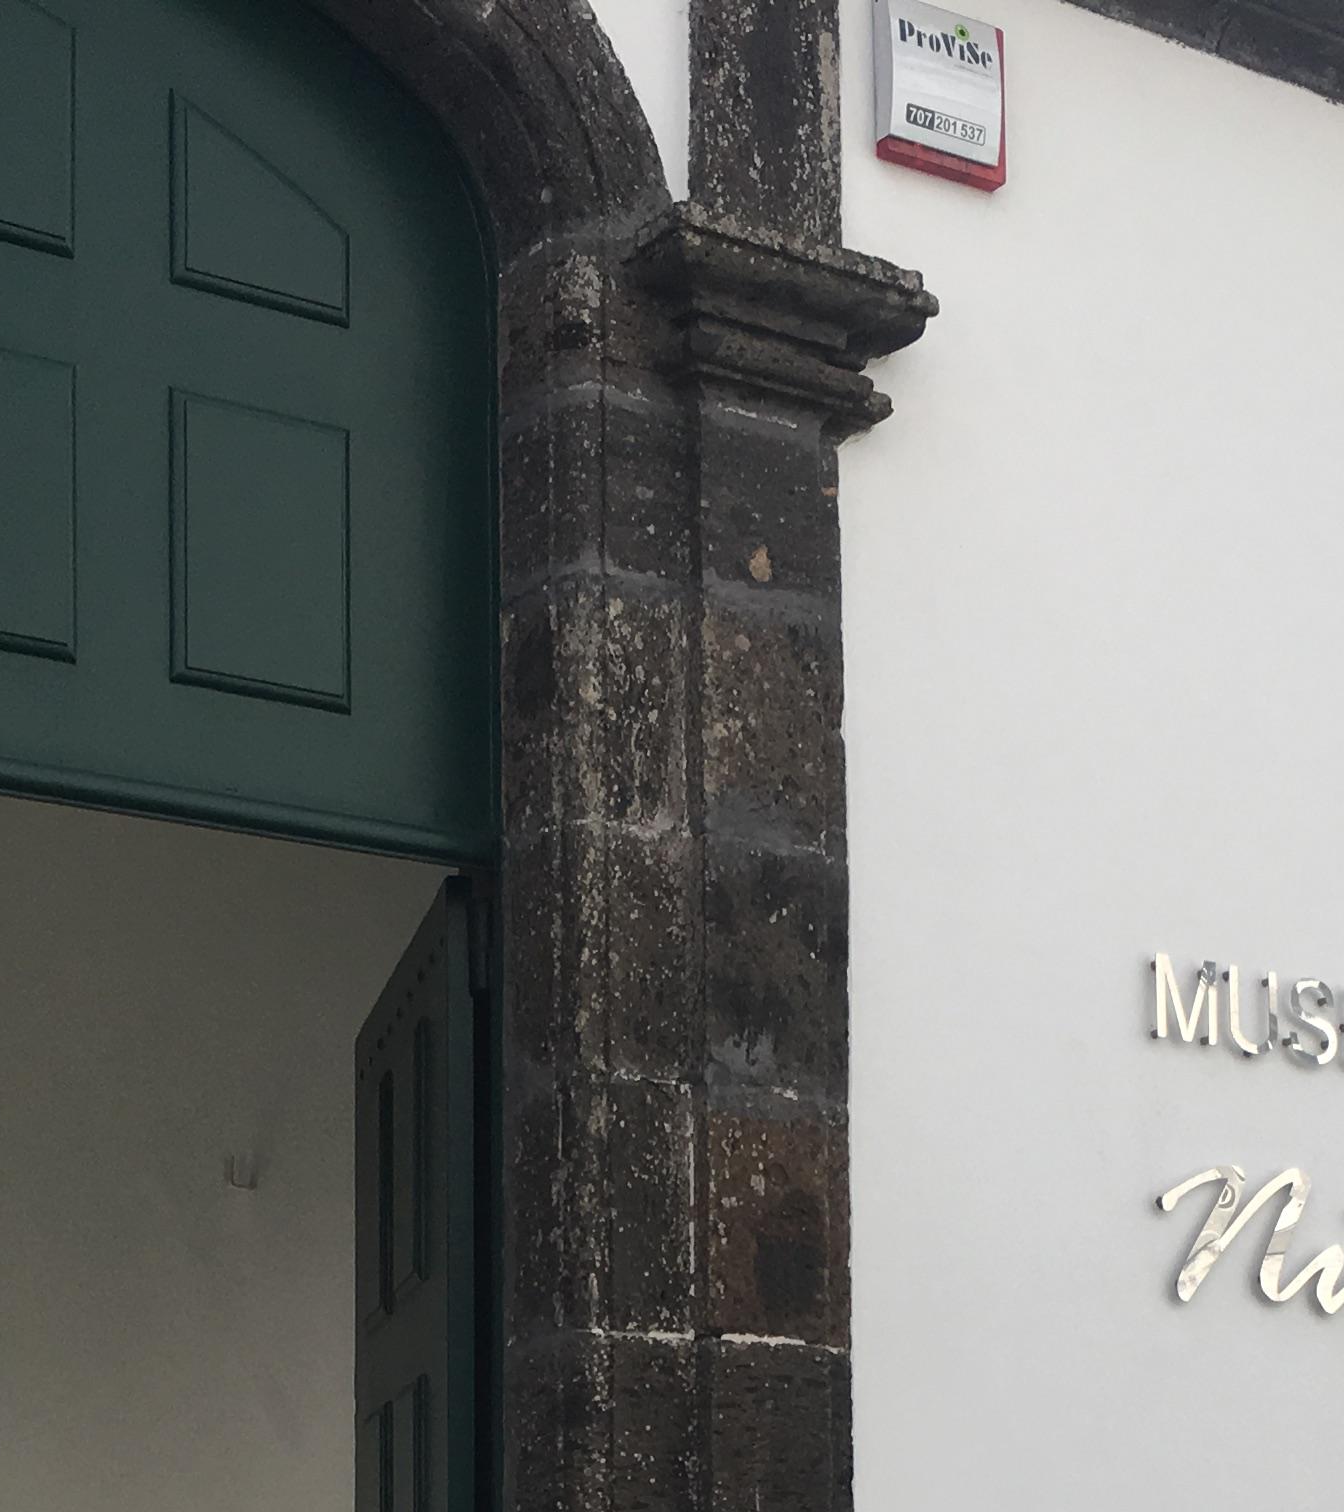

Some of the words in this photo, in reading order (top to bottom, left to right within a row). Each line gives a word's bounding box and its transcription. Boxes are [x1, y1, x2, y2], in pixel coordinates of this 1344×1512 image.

[898, 18, 993, 69] ProViSe
[909, 106, 933, 127] 707
[936, 116, 957, 134] 201
[960, 124, 983, 142] 537
